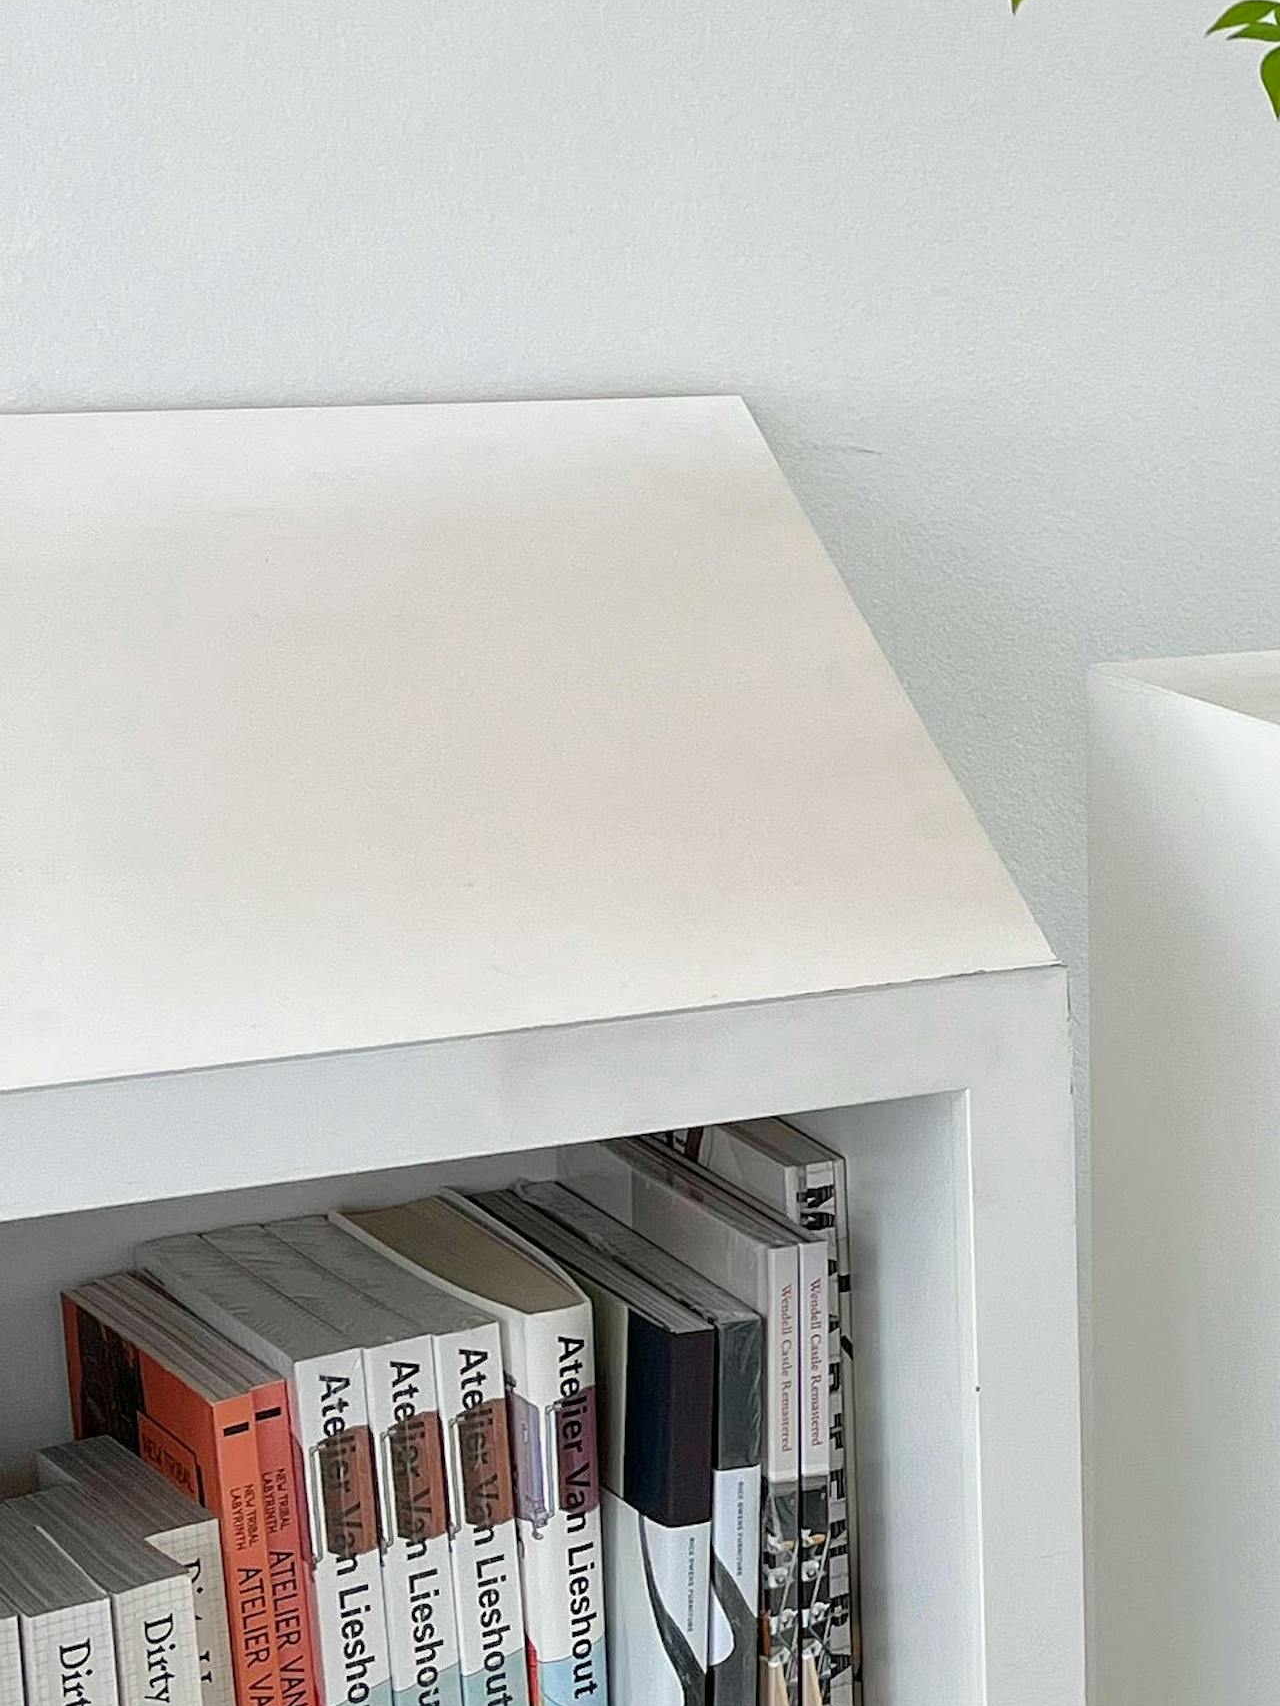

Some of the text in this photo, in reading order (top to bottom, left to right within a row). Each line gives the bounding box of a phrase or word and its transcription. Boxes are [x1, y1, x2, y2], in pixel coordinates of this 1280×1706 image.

[458, 1348, 495, 1466] Atelier
[781, 1285, 792, 1452] Wendell Castle Remastered
[811, 1279, 822, 1446] Wendell Castle Remastered
[318, 1374, 355, 1494] Atelier
[389, 1361, 426, 1478] Atelier
[230, 1487, 246, 1551] LABYRINTH
[243, 1483, 260, 1549] NEW TRIBAL
[262, 1471, 277, 1536] LABYRINTH
[276, 1467, 292, 1531] NEW TRIBAL
[335, 1500, 362, 1576] Van
[405, 1485, 434, 1560] Van
[473, 1472, 500, 1547] Van
[558, 1335, 598, 1699] Atelier Van Lieshout
[237, 1567, 270, 1669] ATELIER
[269, 1550, 301, 1650] ATELIER
[144, 1613, 173, 1703] Dirty
